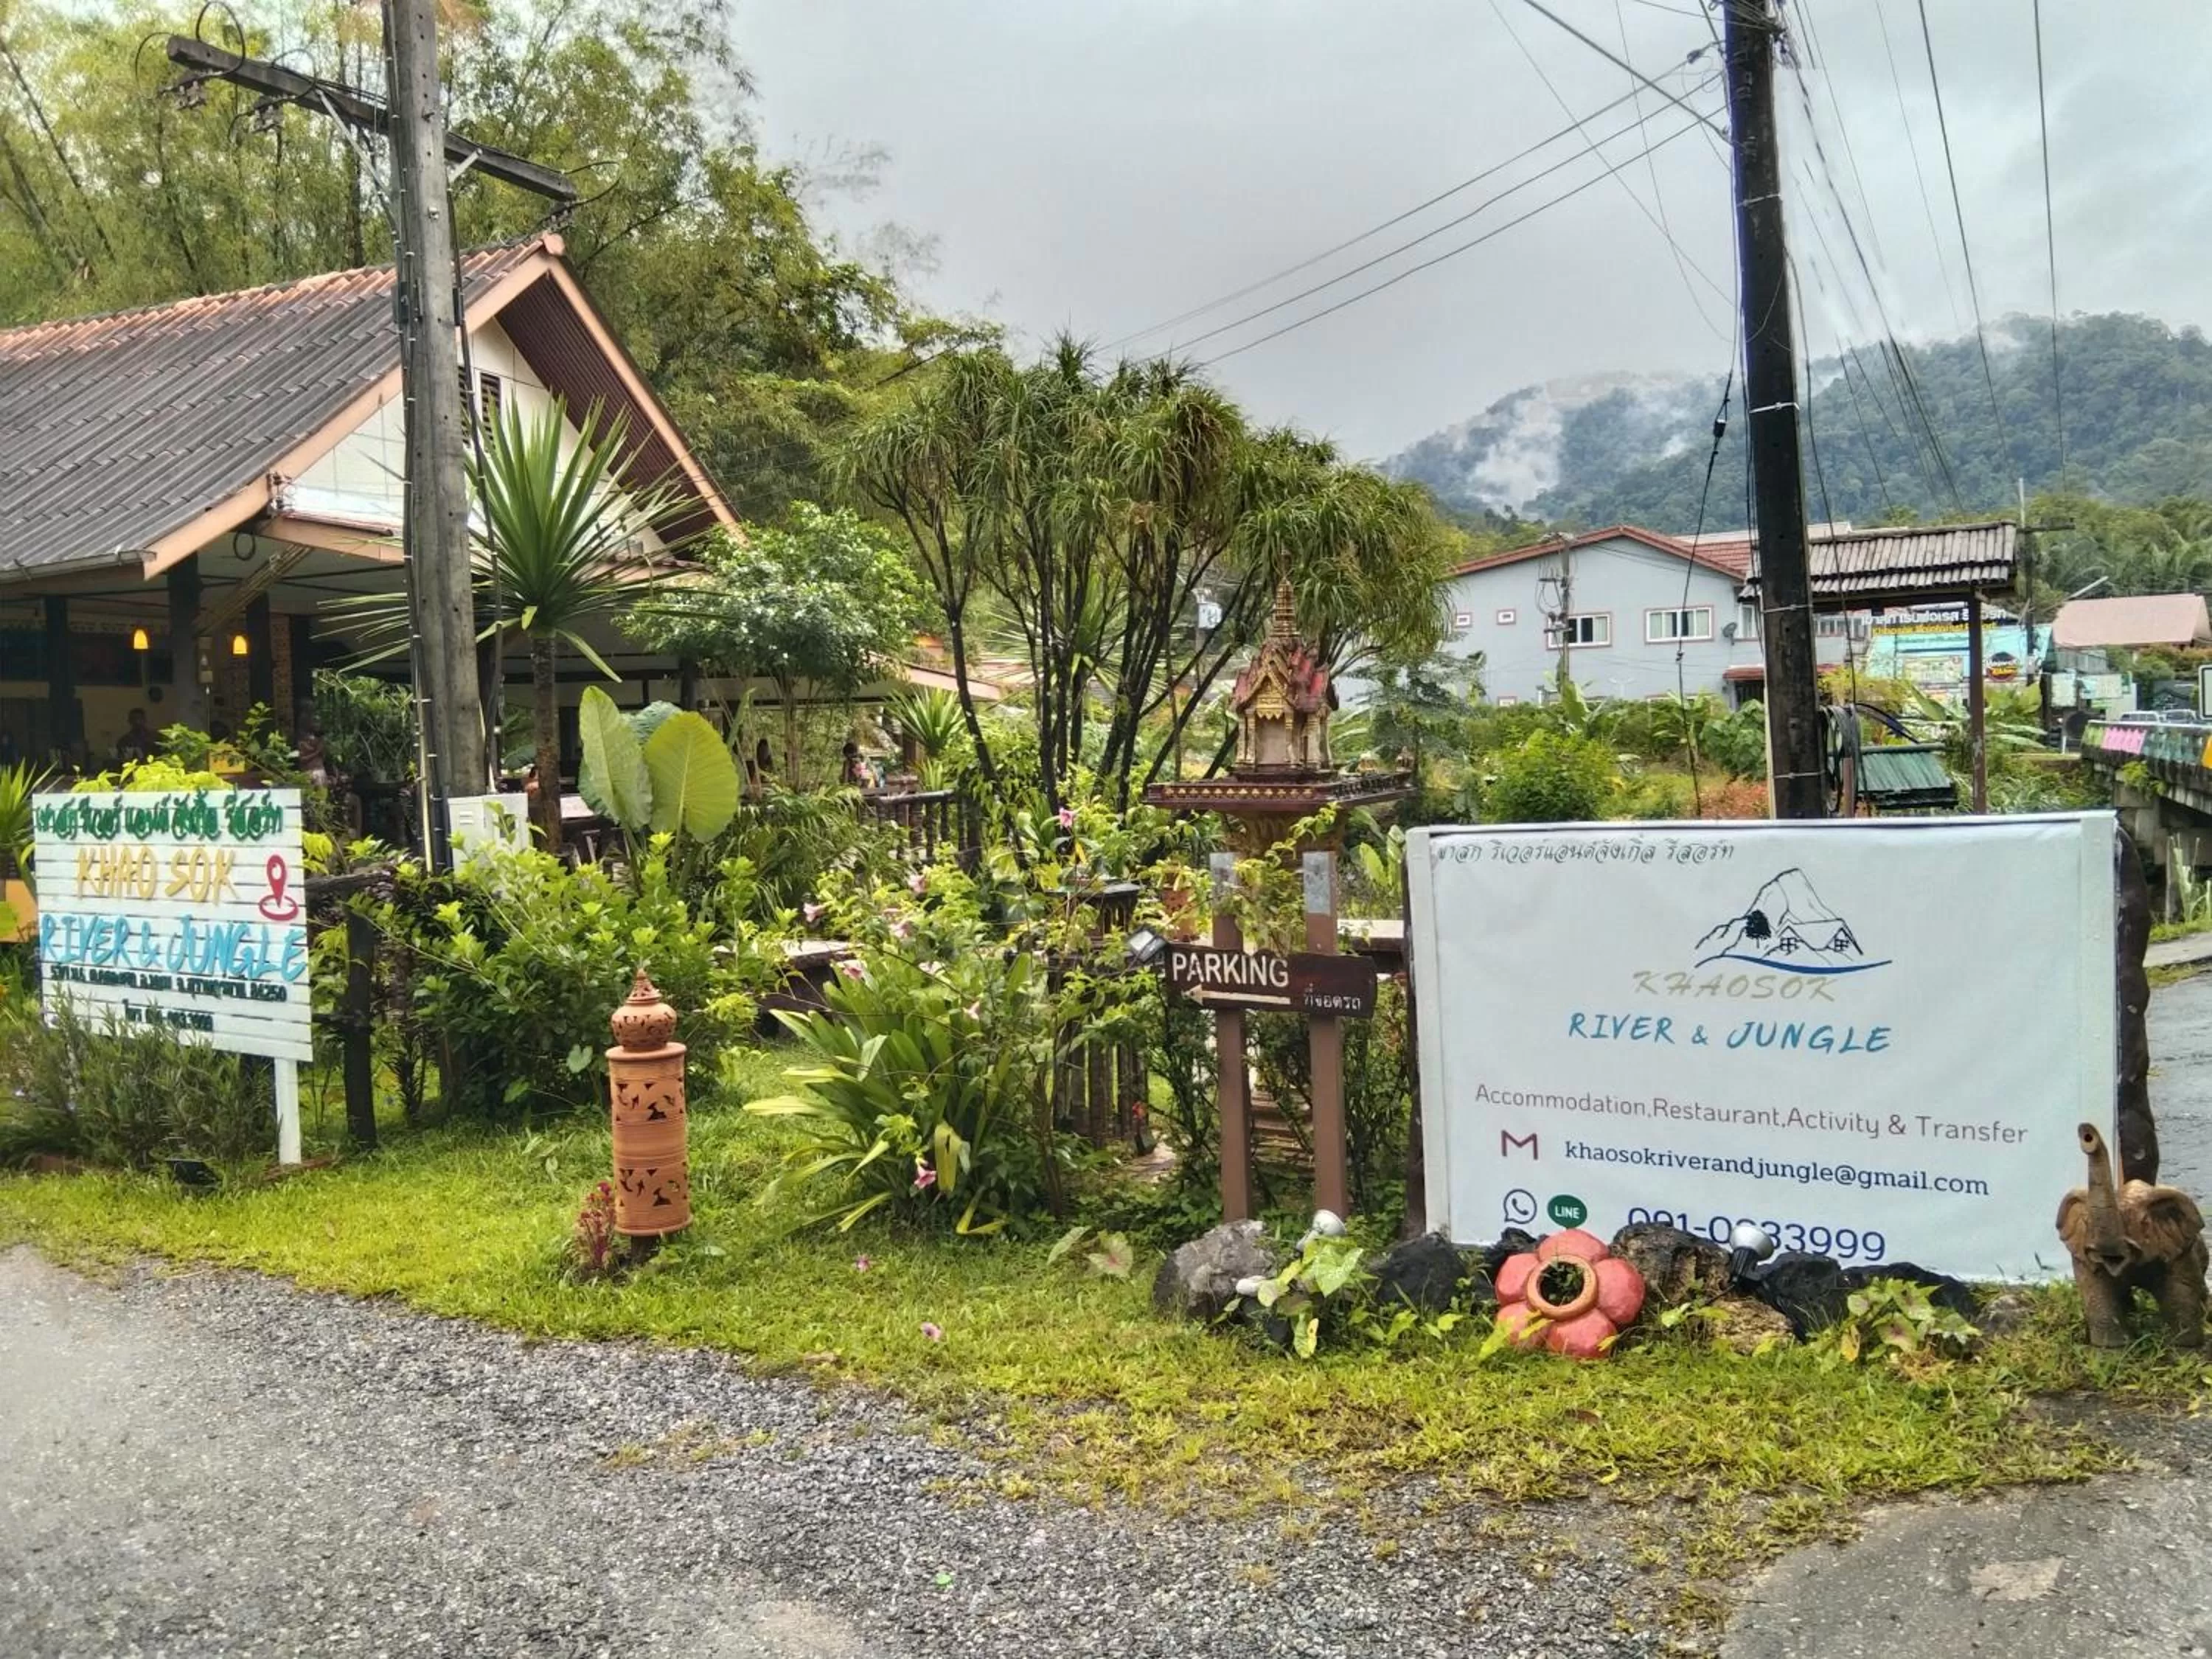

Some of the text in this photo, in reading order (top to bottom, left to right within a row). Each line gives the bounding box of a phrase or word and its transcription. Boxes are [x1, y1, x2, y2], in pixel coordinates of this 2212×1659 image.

[77, 846, 240, 905] KHAO SOK
[40, 914, 307, 981] RIVER & JUNGLE
[1172, 953, 1290, 988] PARKING
[1632, 970, 1838, 1002] KHAOSOK
[1569, 1012, 1892, 1054] RIVER & JUNGLE
[1888, 1114, 1907, 1135] &
[1915, 1116, 2028, 1144] Transfer
[1565, 1141, 1989, 1196] khaosokriverandjungle@gmail.com
[1555, 1204, 1579, 1219] LINE
